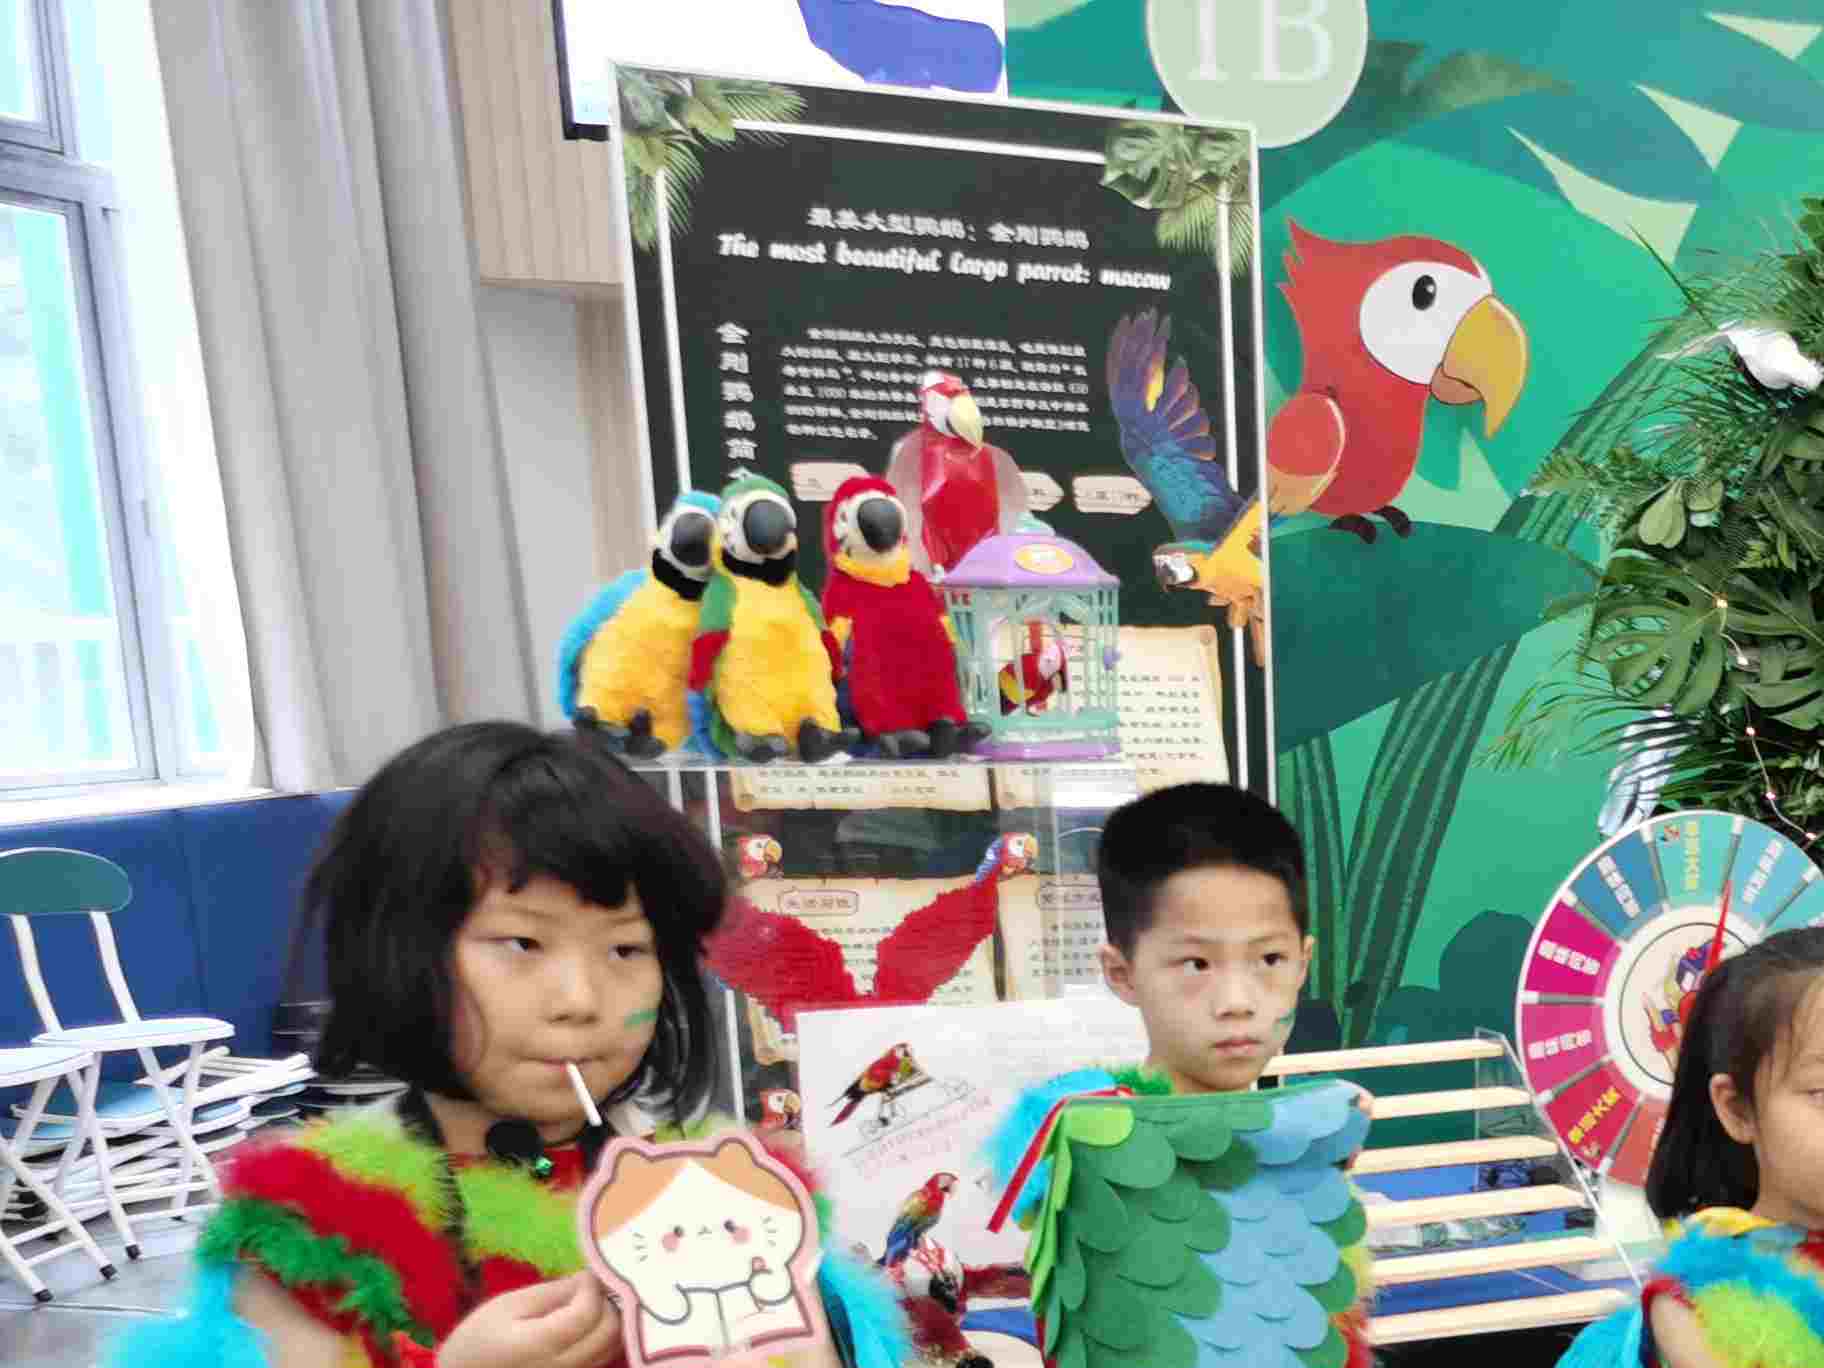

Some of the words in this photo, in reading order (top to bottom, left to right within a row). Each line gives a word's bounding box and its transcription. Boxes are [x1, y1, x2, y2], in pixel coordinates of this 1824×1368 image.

[717, 233, 760, 260] The
[769, 241, 827, 264] most
[836, 240, 942, 275] beautiful
